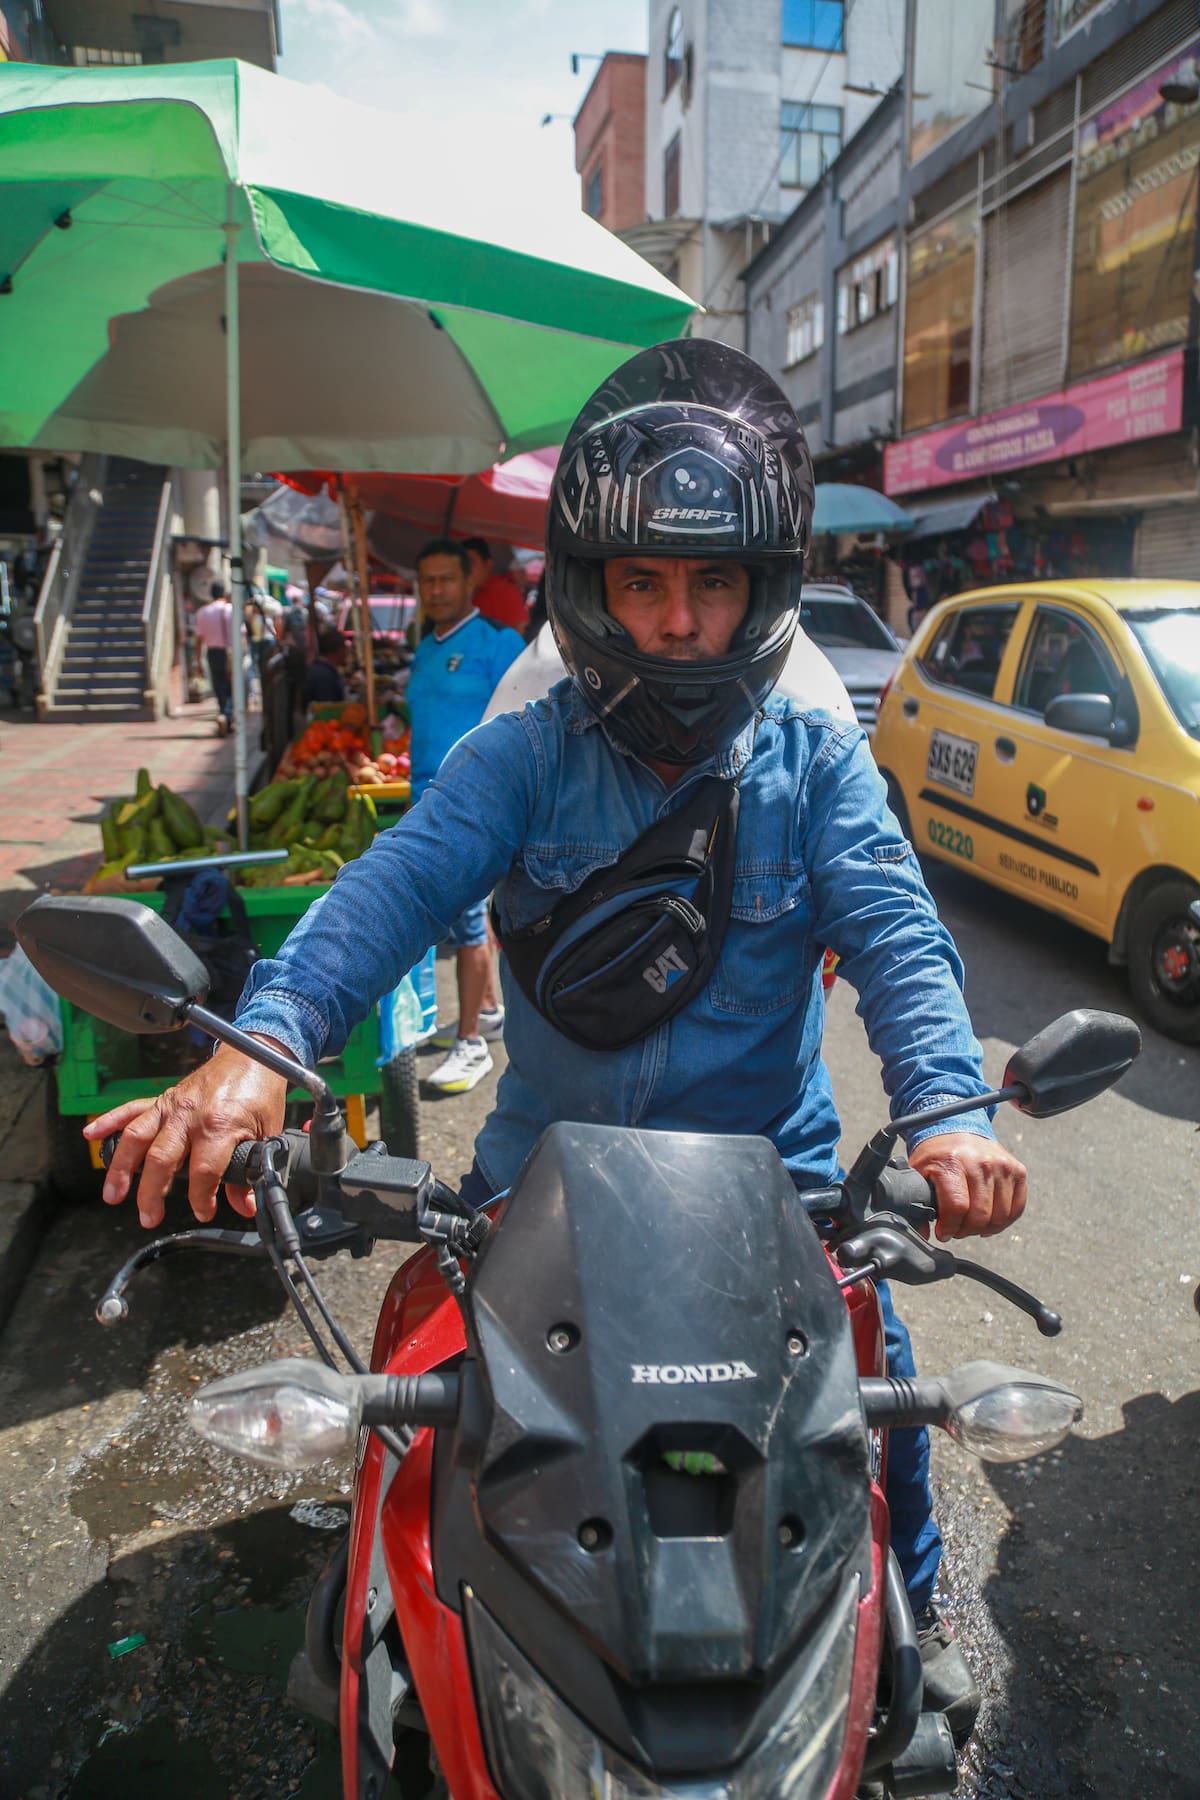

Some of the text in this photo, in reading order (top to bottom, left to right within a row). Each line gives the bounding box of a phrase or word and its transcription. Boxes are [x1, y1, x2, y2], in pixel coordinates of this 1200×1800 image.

[652, 507, 738, 523] SHAFT
[928, 818, 974, 860] 02220
[999, 852, 1037, 881] SERVICIO
[643, 944, 689, 993] CAT
[631, 1361, 757, 1385] HONDA
